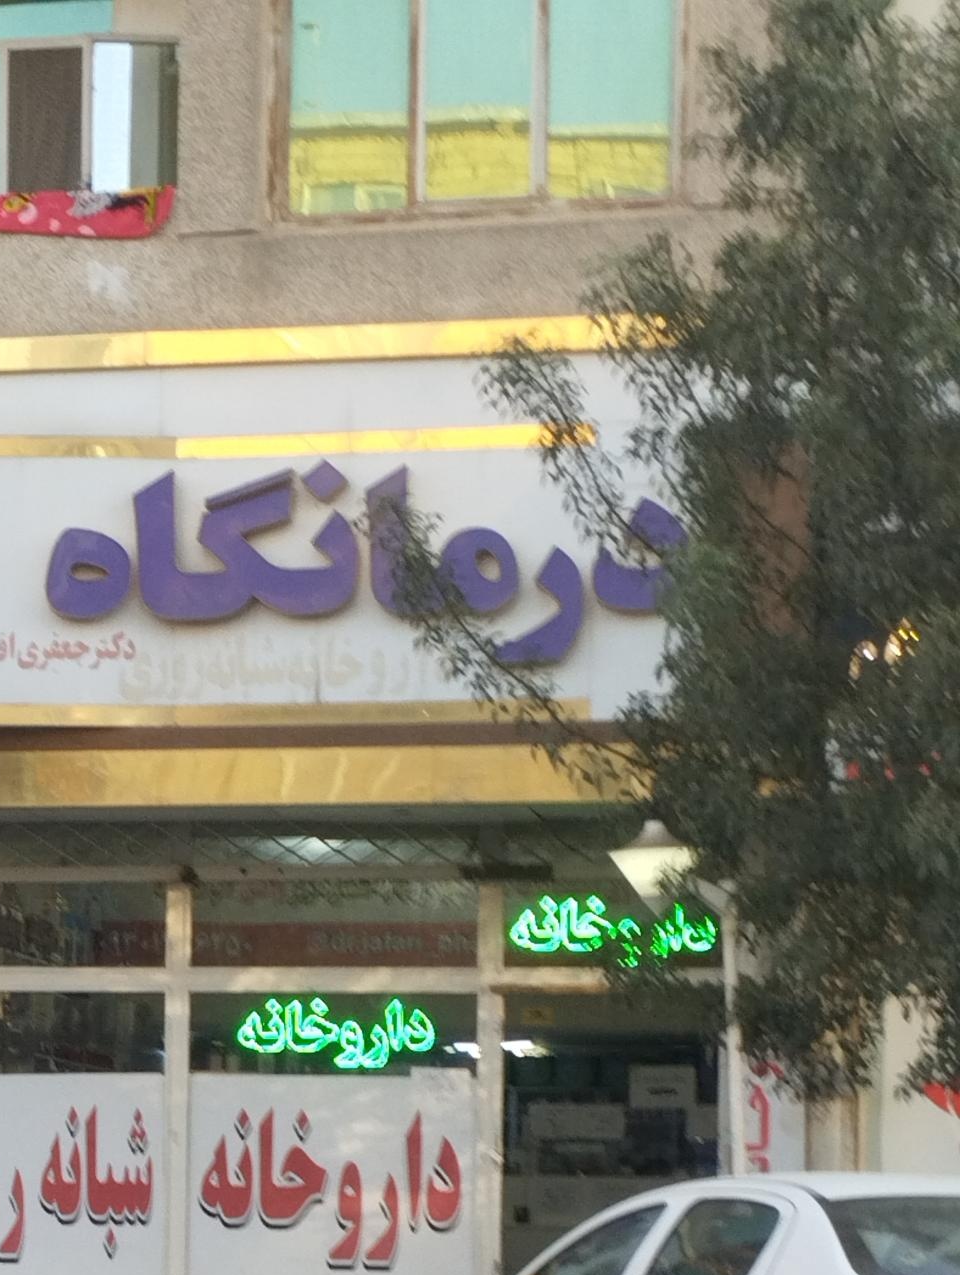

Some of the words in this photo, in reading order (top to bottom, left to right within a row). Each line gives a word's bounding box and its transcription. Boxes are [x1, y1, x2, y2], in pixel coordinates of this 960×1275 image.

[17, 632, 89, 673] جعفری
[88, 631, 136, 669] دکتر
[238, 998, 435, 1068] داروخانه
[39, 1104, 153, 1258] شبانه
[199, 1106, 464, 1270] داروخانه
